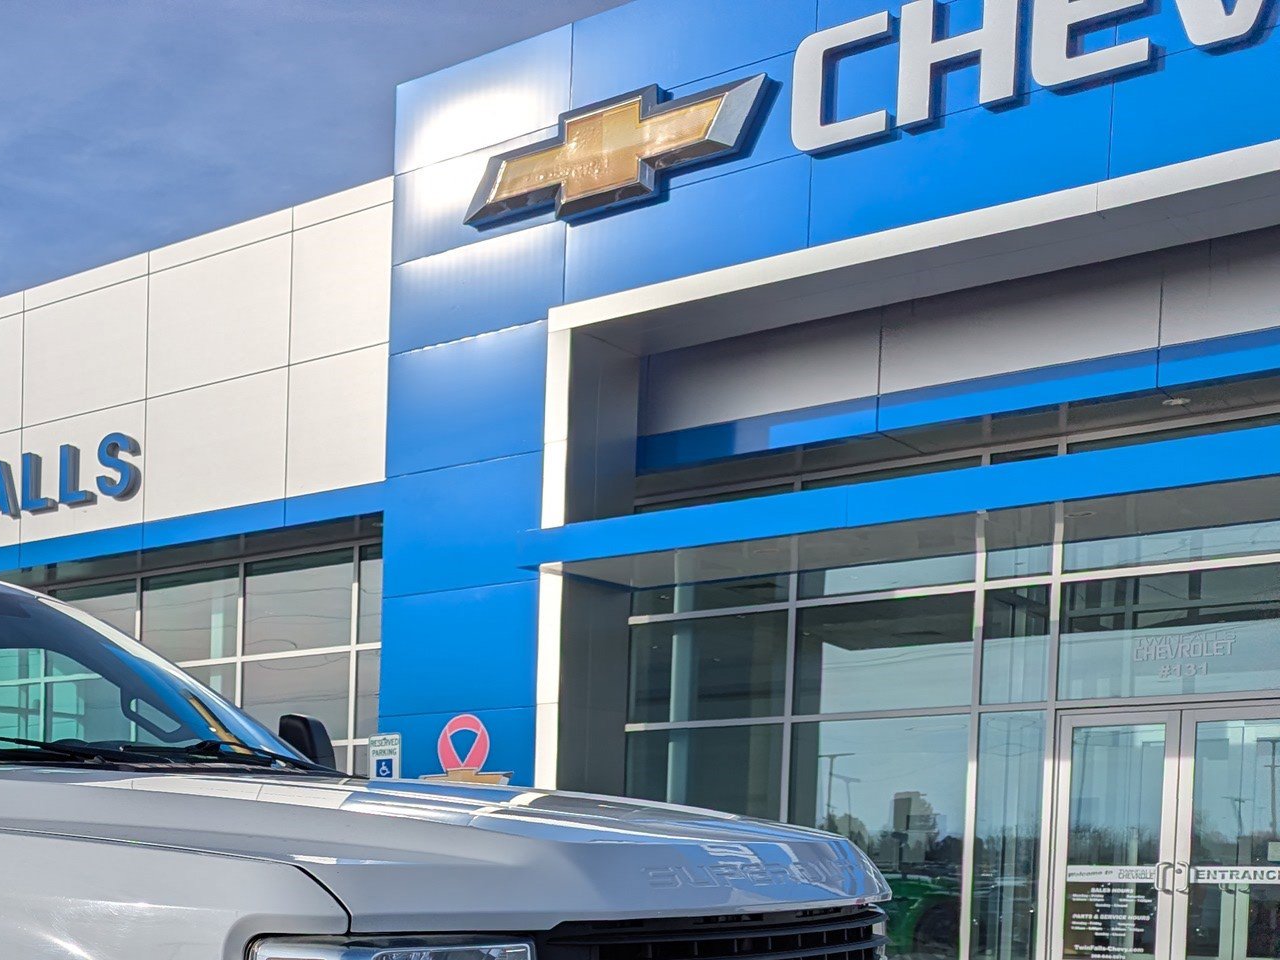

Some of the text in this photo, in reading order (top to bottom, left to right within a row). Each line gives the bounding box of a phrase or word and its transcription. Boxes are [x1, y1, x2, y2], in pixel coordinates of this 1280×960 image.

[1134, 639, 1236, 662] CHEVROLET
[1160, 661, 1209, 679] #131
[372, 748, 397, 757] PARKING
[1197, 869, 1280, 881] ENTRANC
